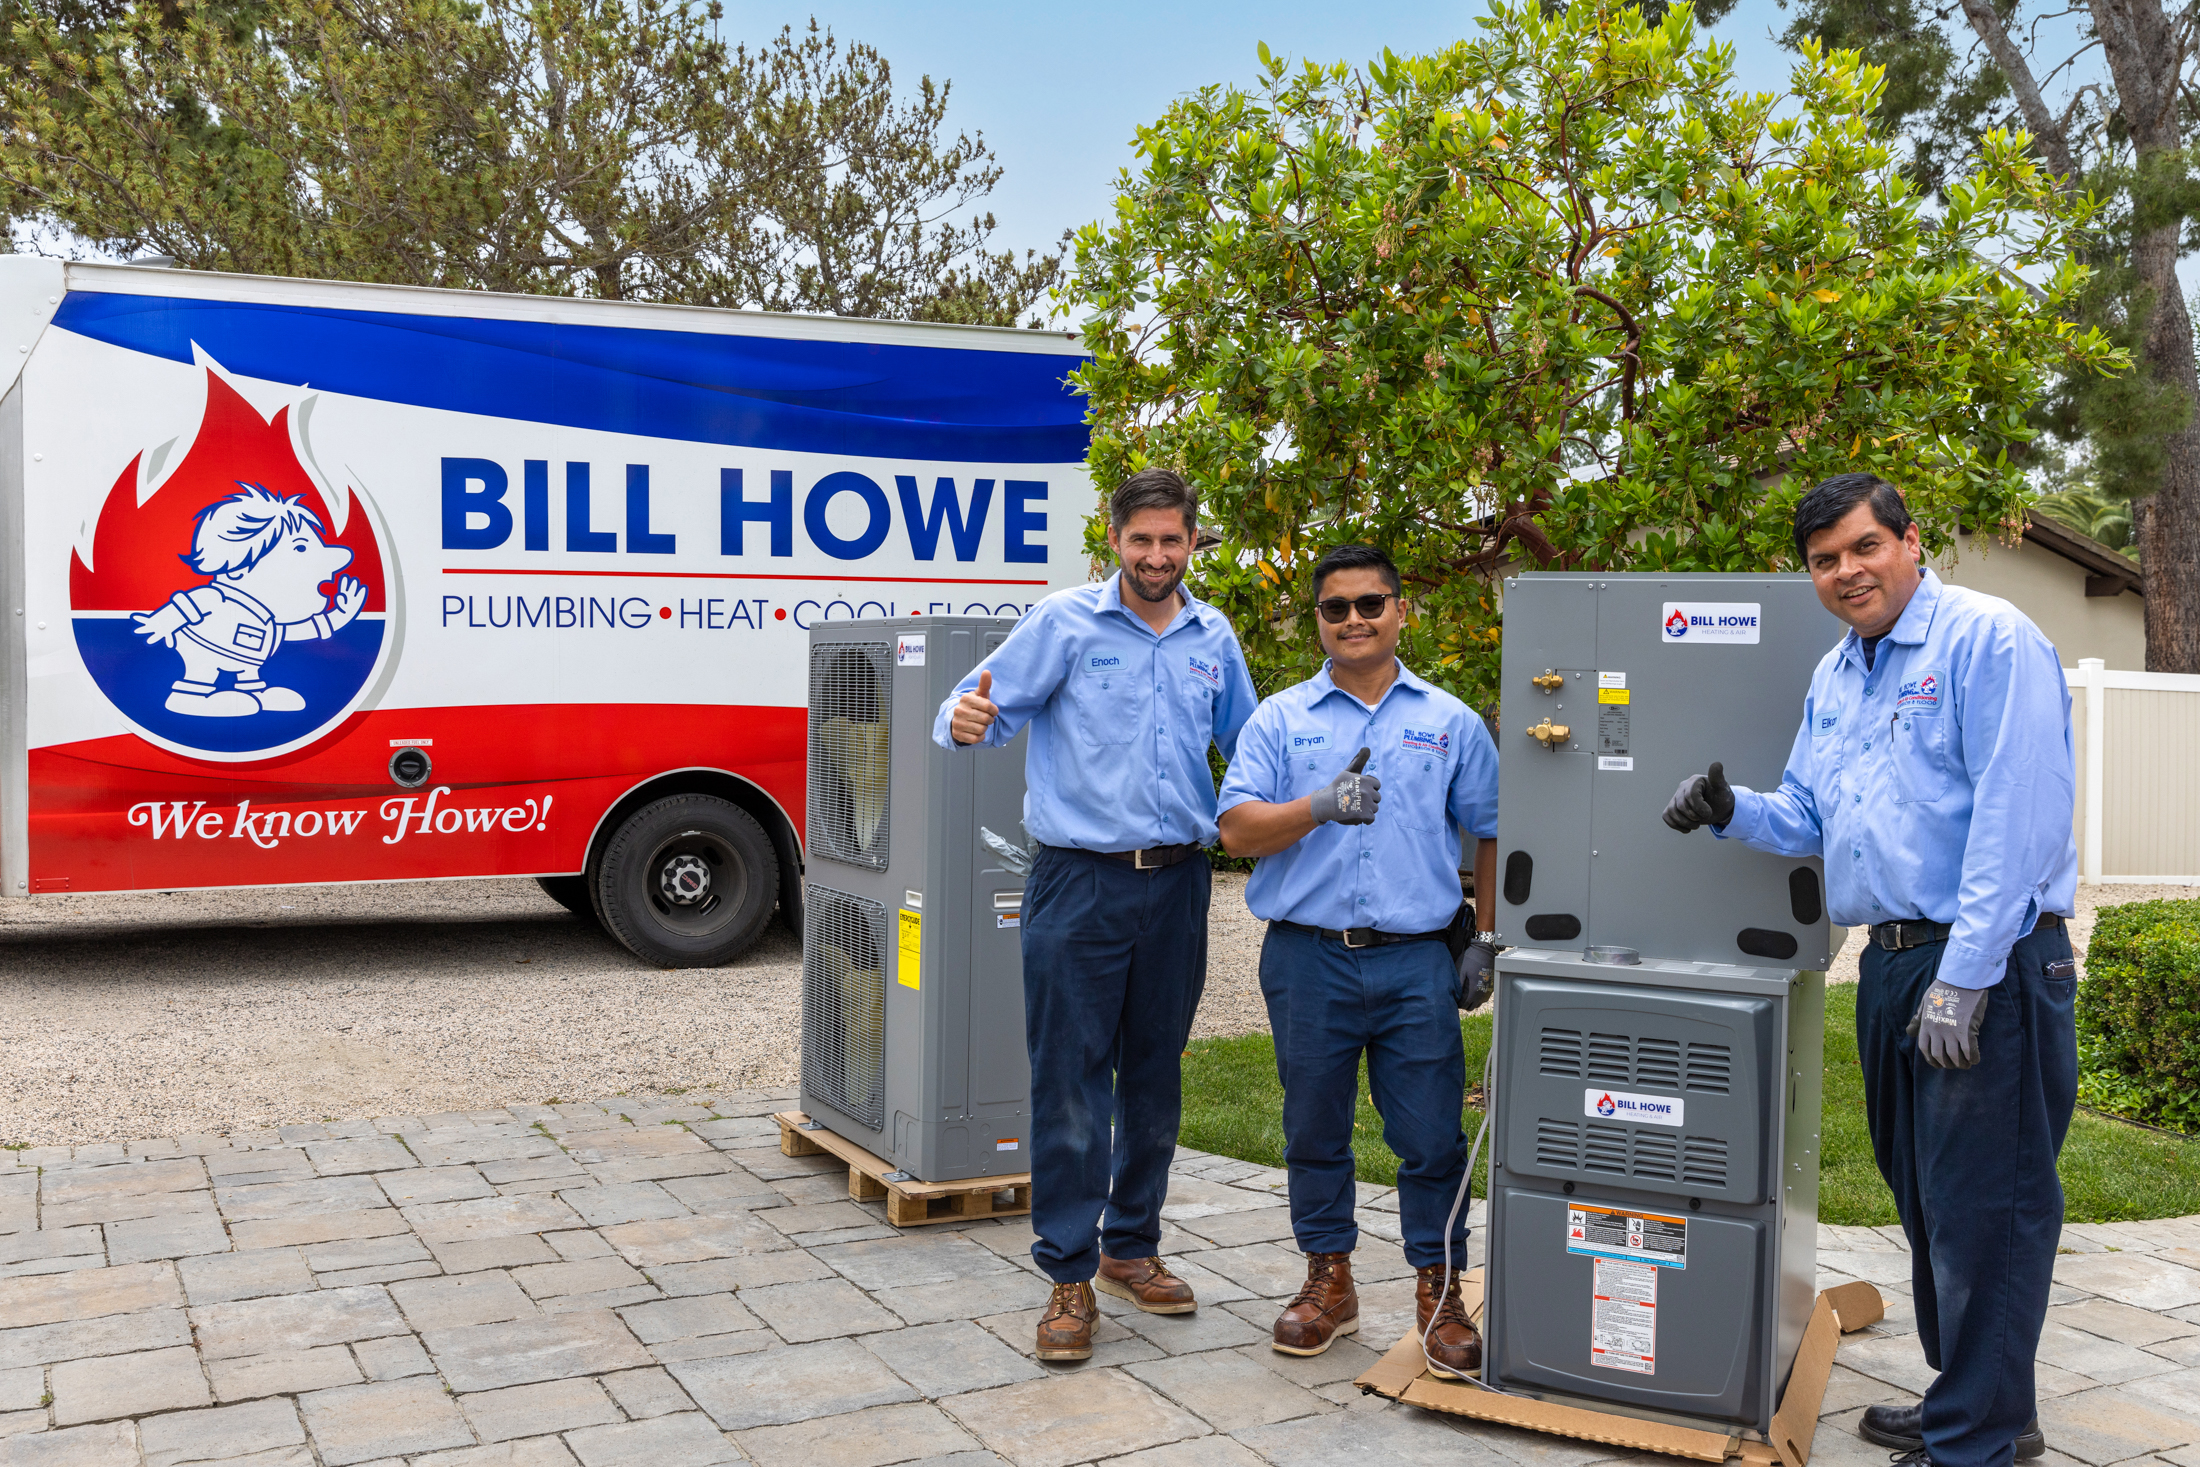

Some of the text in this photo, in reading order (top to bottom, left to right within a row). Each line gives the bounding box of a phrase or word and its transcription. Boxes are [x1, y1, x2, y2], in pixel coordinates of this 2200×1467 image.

[441, 457, 1048, 564] BILL HOWE
[443, 596, 651, 629] PLUMBING
[681, 598, 769, 630] HEAT
[1690, 616, 1757, 626] BILL HOWE
[1091, 656, 1120, 667] Enoch
[1294, 735, 1325, 747] Bryan
[128, 786, 552, 848] We know Howe!
[1617, 1100, 1671, 1114] BILL HOWE
[1615, 1210, 1644, 1219] WARNING
